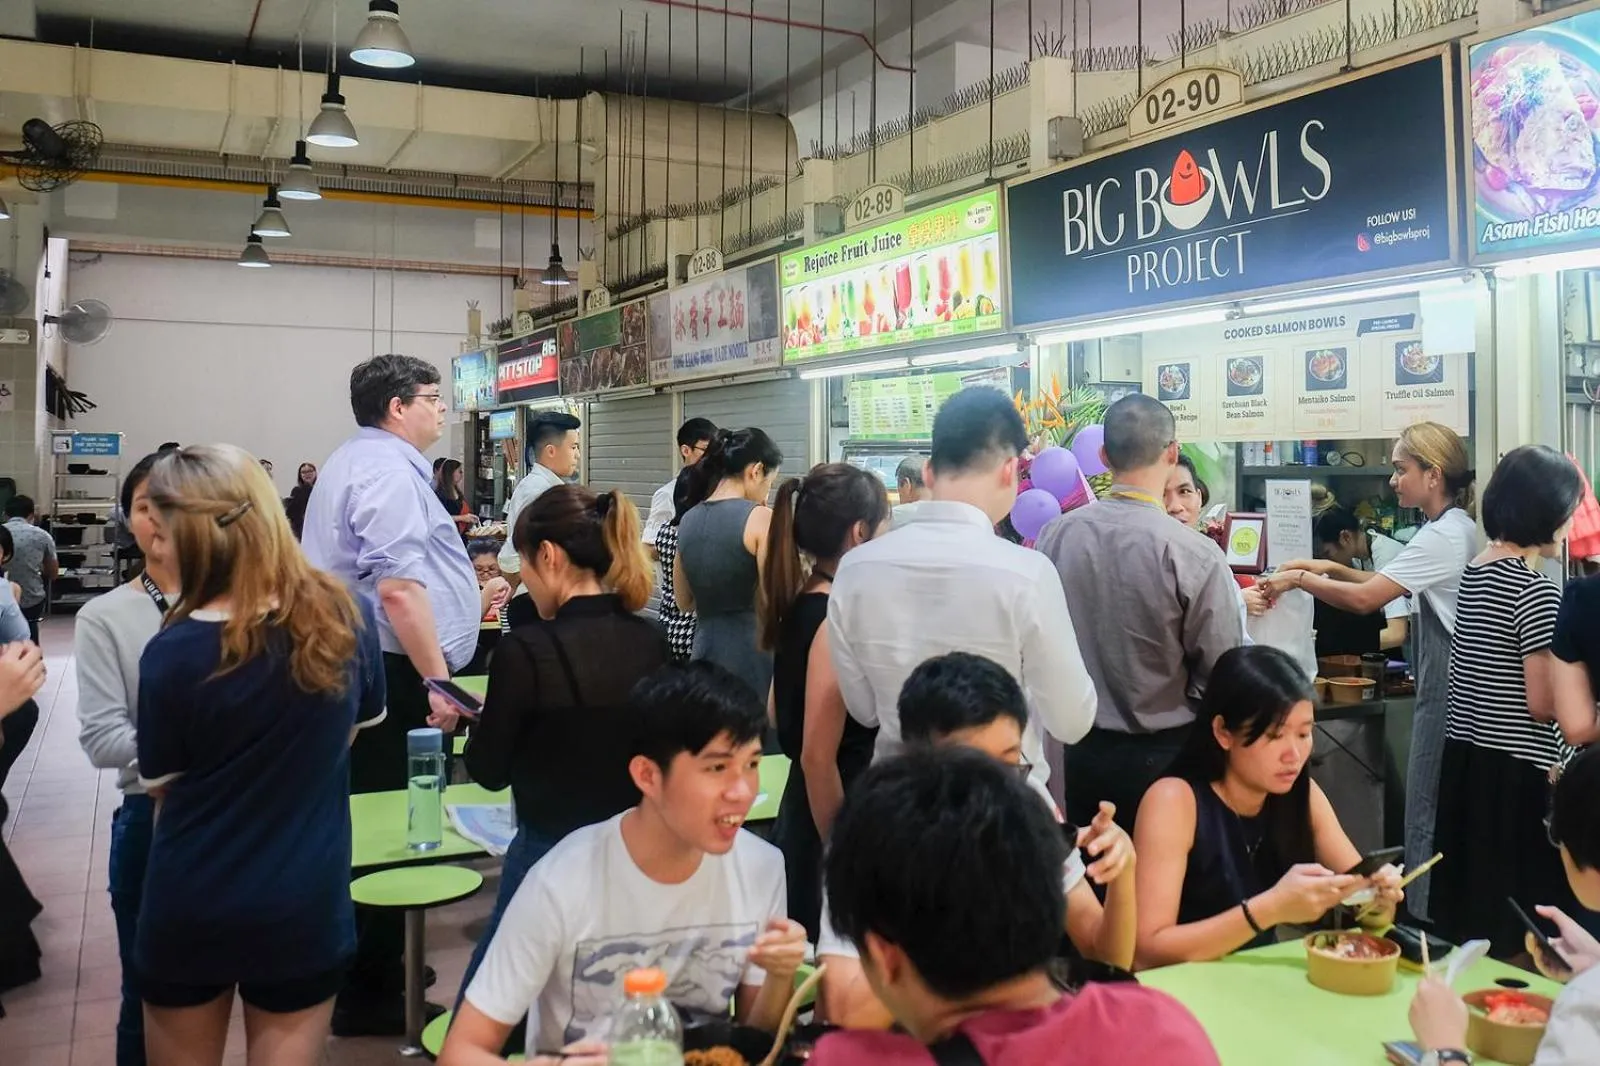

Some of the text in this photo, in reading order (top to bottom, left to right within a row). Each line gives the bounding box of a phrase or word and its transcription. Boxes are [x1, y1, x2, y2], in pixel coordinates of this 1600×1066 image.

[1146, 73, 1221, 124] 02-90
[1063, 119, 1332, 256] BIG BOWLS
[854, 189, 893, 221] 02-89
[1367, 211, 1400, 227] FOLLOW
[1481, 220, 1530, 244] Asam
[1533, 212, 1570, 235] Fish
[1374, 224, 1431, 245] @bigbowlsproj
[693, 251, 717, 275] 02-88
[804, 249, 838, 274] Rejoice
[841, 242, 869, 263] Fruit
[871, 232, 902, 254] Juice
[1127, 230, 1252, 293] PROJECT
[1224, 315, 1346, 340] COOKED SALMON BOWLS
[542, 338, 556, 356] 86
[1298, 394, 1356, 405] Mentaiko Salmon
[1385, 388, 1455, 400] Truffle Oil Salmon
[1226, 409, 1265, 419] Bean Salmon
